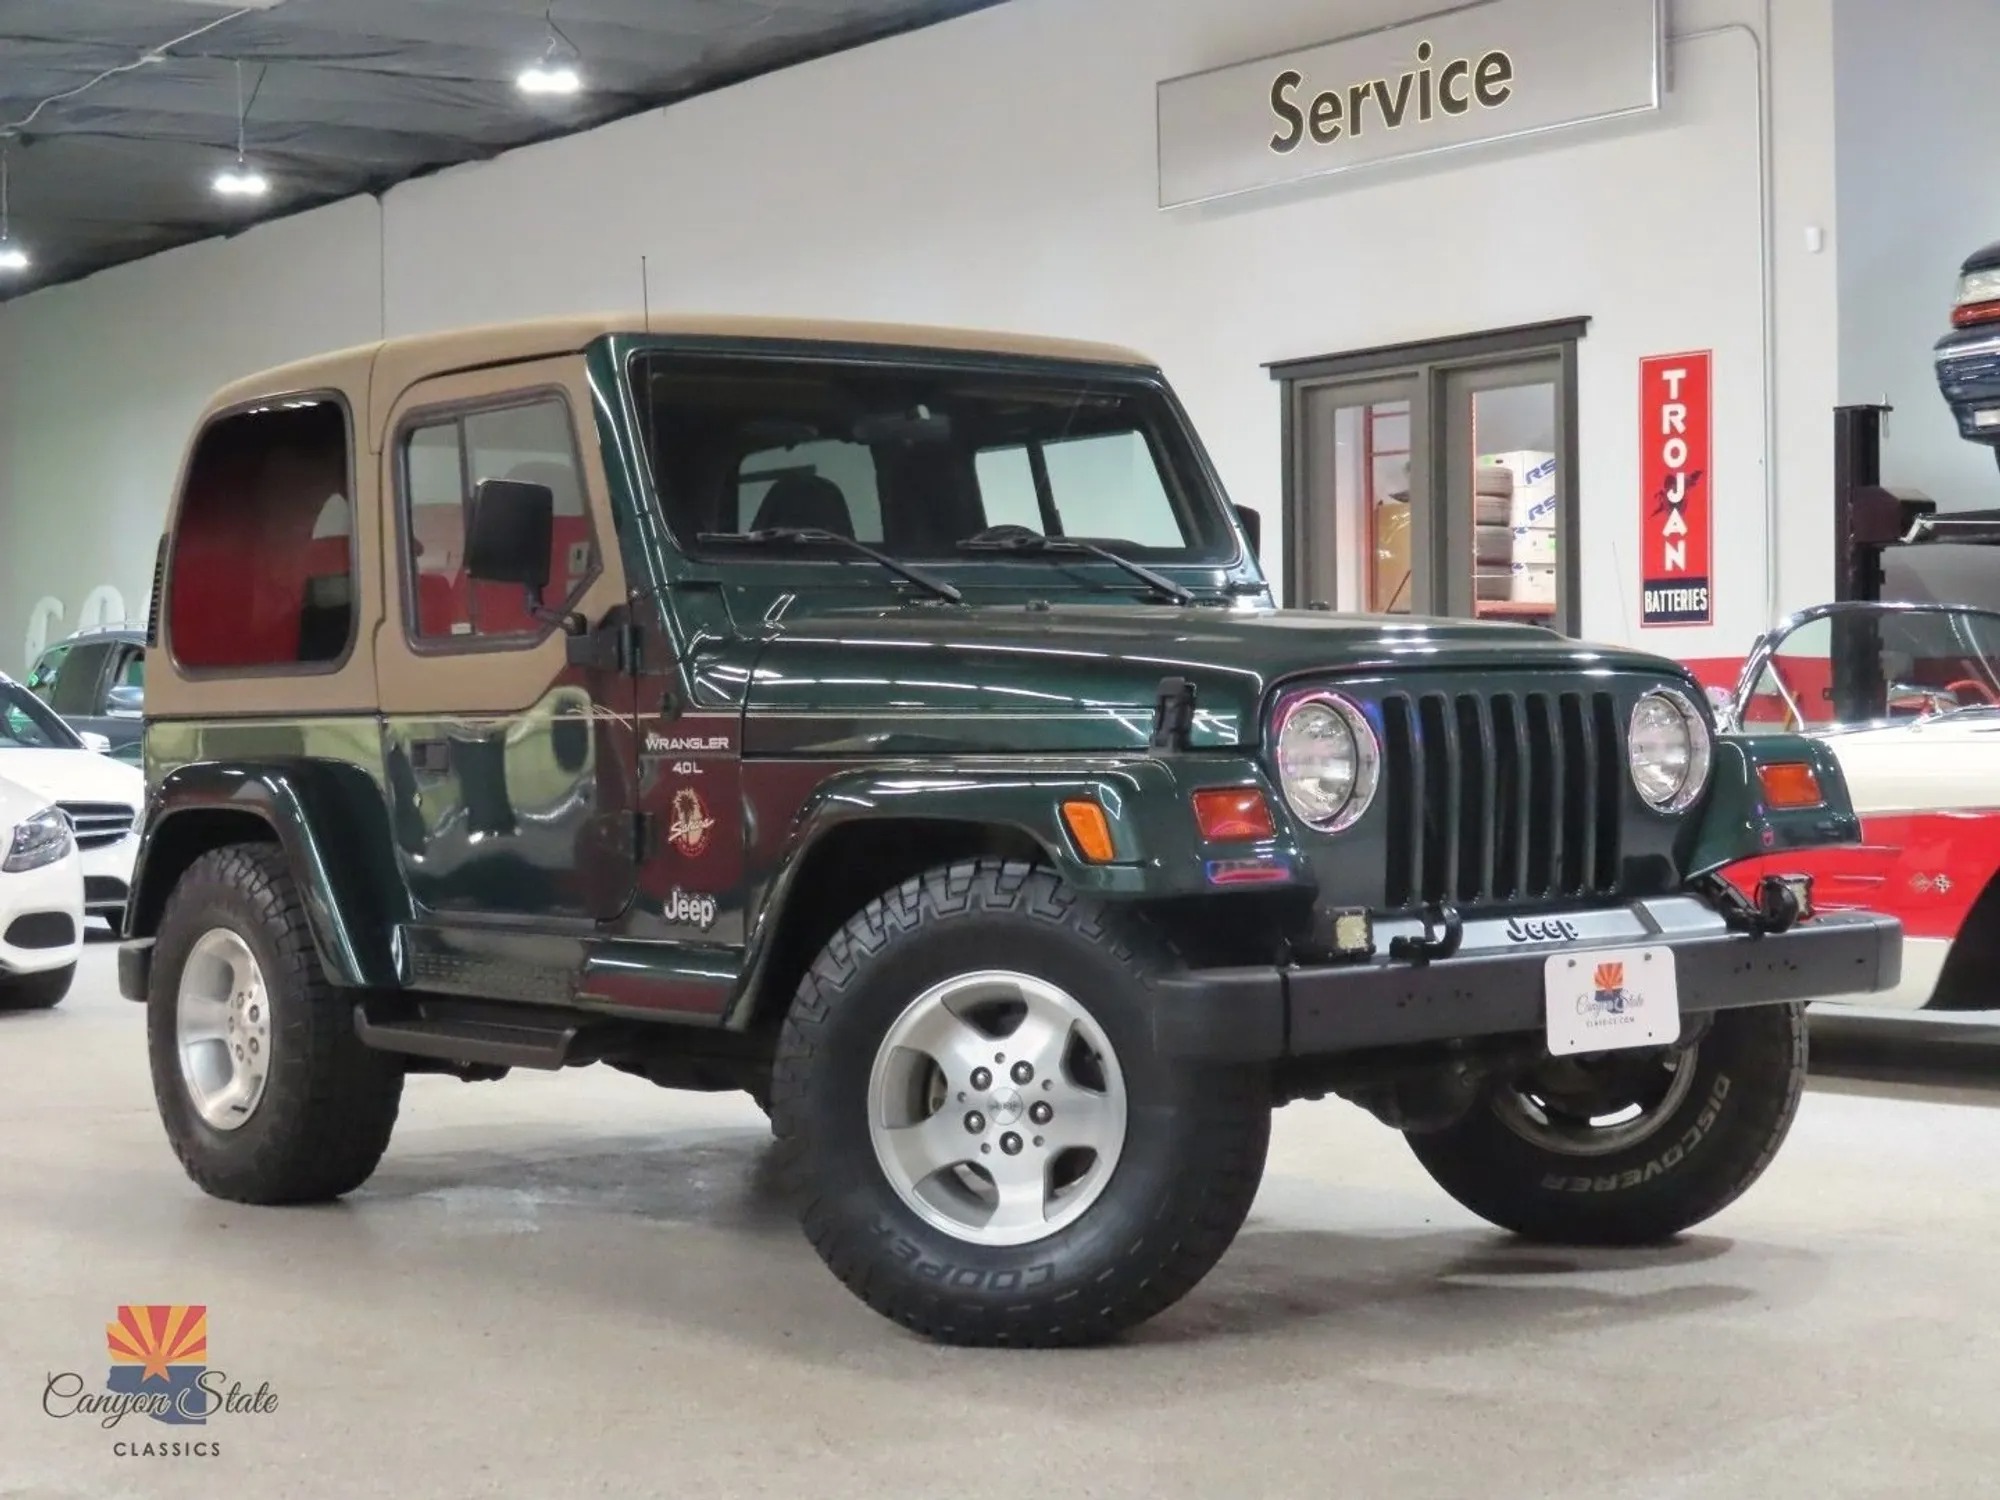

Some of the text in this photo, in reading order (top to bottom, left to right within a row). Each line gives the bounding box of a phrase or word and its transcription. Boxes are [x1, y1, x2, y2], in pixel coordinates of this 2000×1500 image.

[1268, 40, 1514, 155] Service
[1661, 368, 1688, 572] TROJAN
[1644, 587, 1708, 613] BATTERIES
[645, 737, 729, 751] WRANGLER
[664, 891, 715, 928] Jeep
[1506, 917, 1579, 943] Jeep
[1540, 1073, 1732, 1192] DISCOVERER
